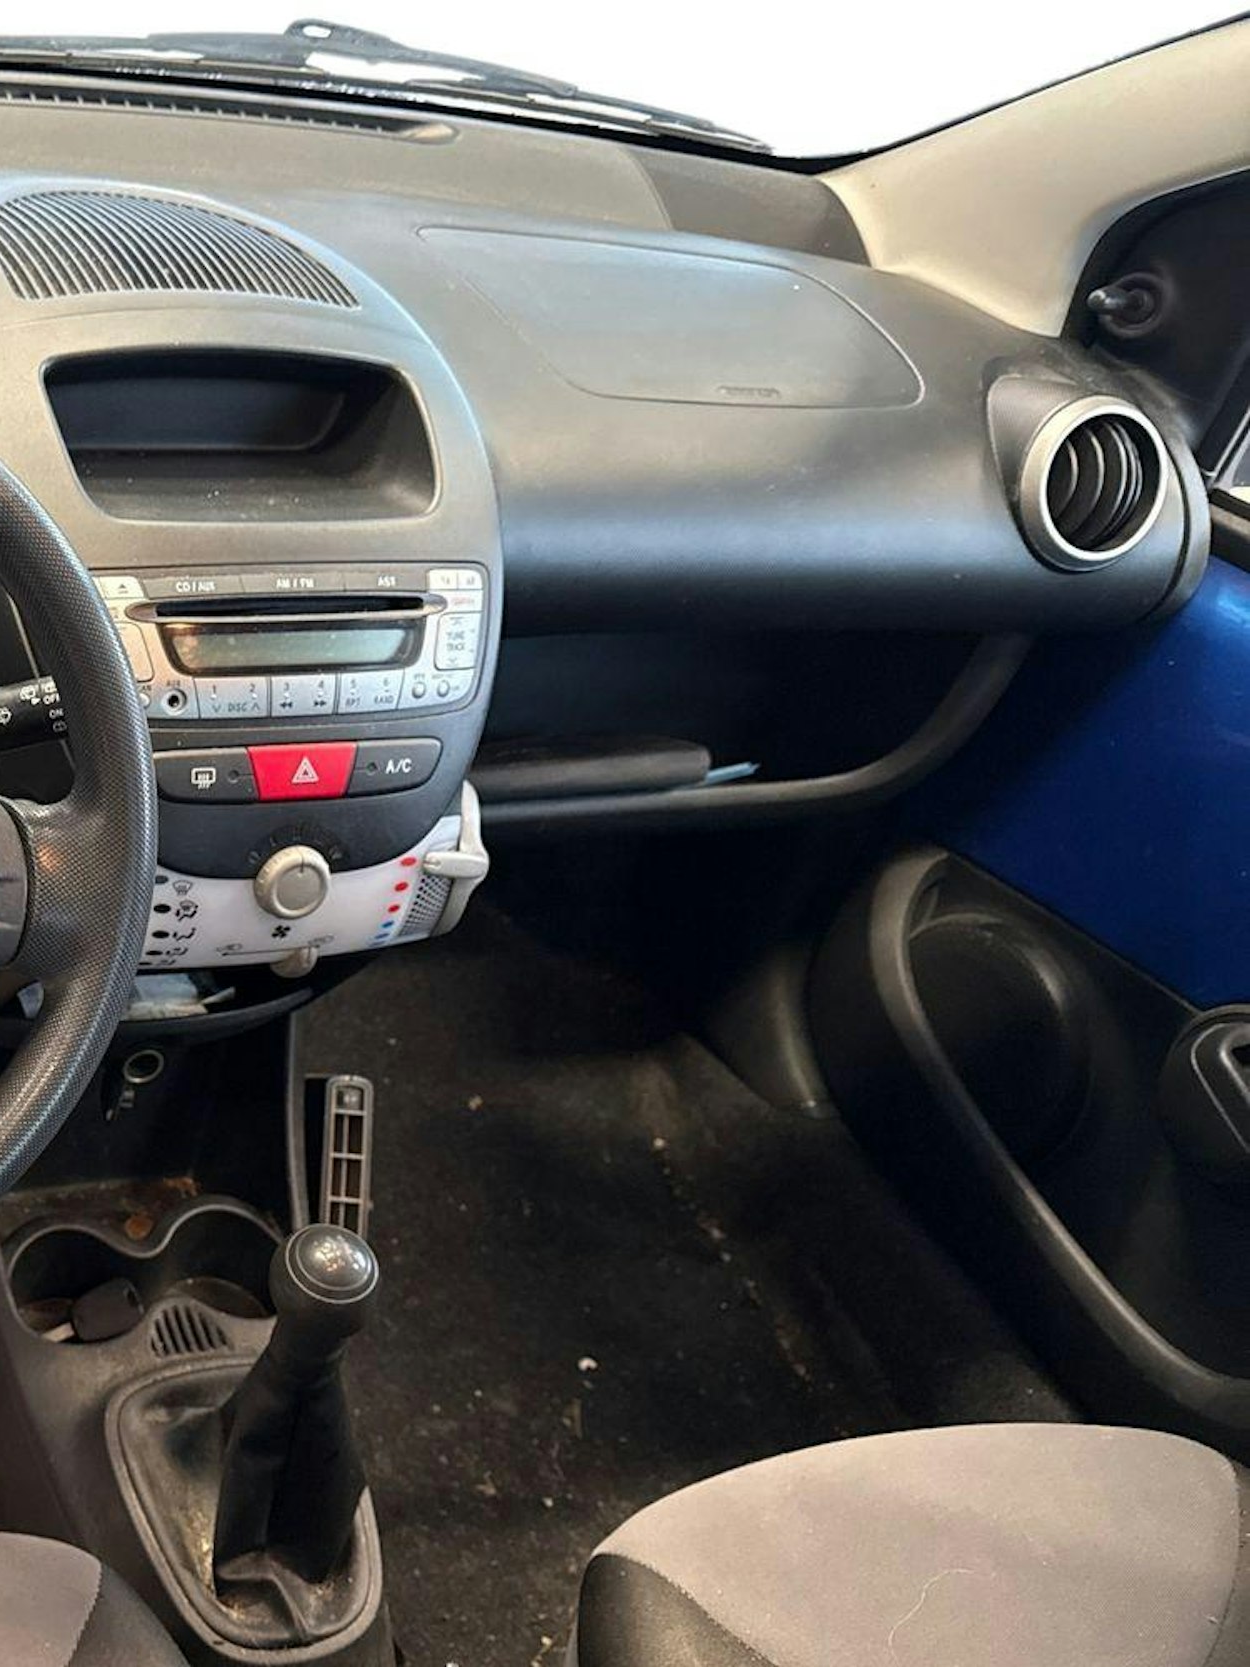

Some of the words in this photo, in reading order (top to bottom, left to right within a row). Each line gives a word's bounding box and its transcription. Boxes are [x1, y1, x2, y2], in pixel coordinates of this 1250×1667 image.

[283, 682, 290, 692] 3
[317, 680, 325, 690] 4
[227, 702, 248, 713] DISC
[384, 757, 413, 774] A/C
